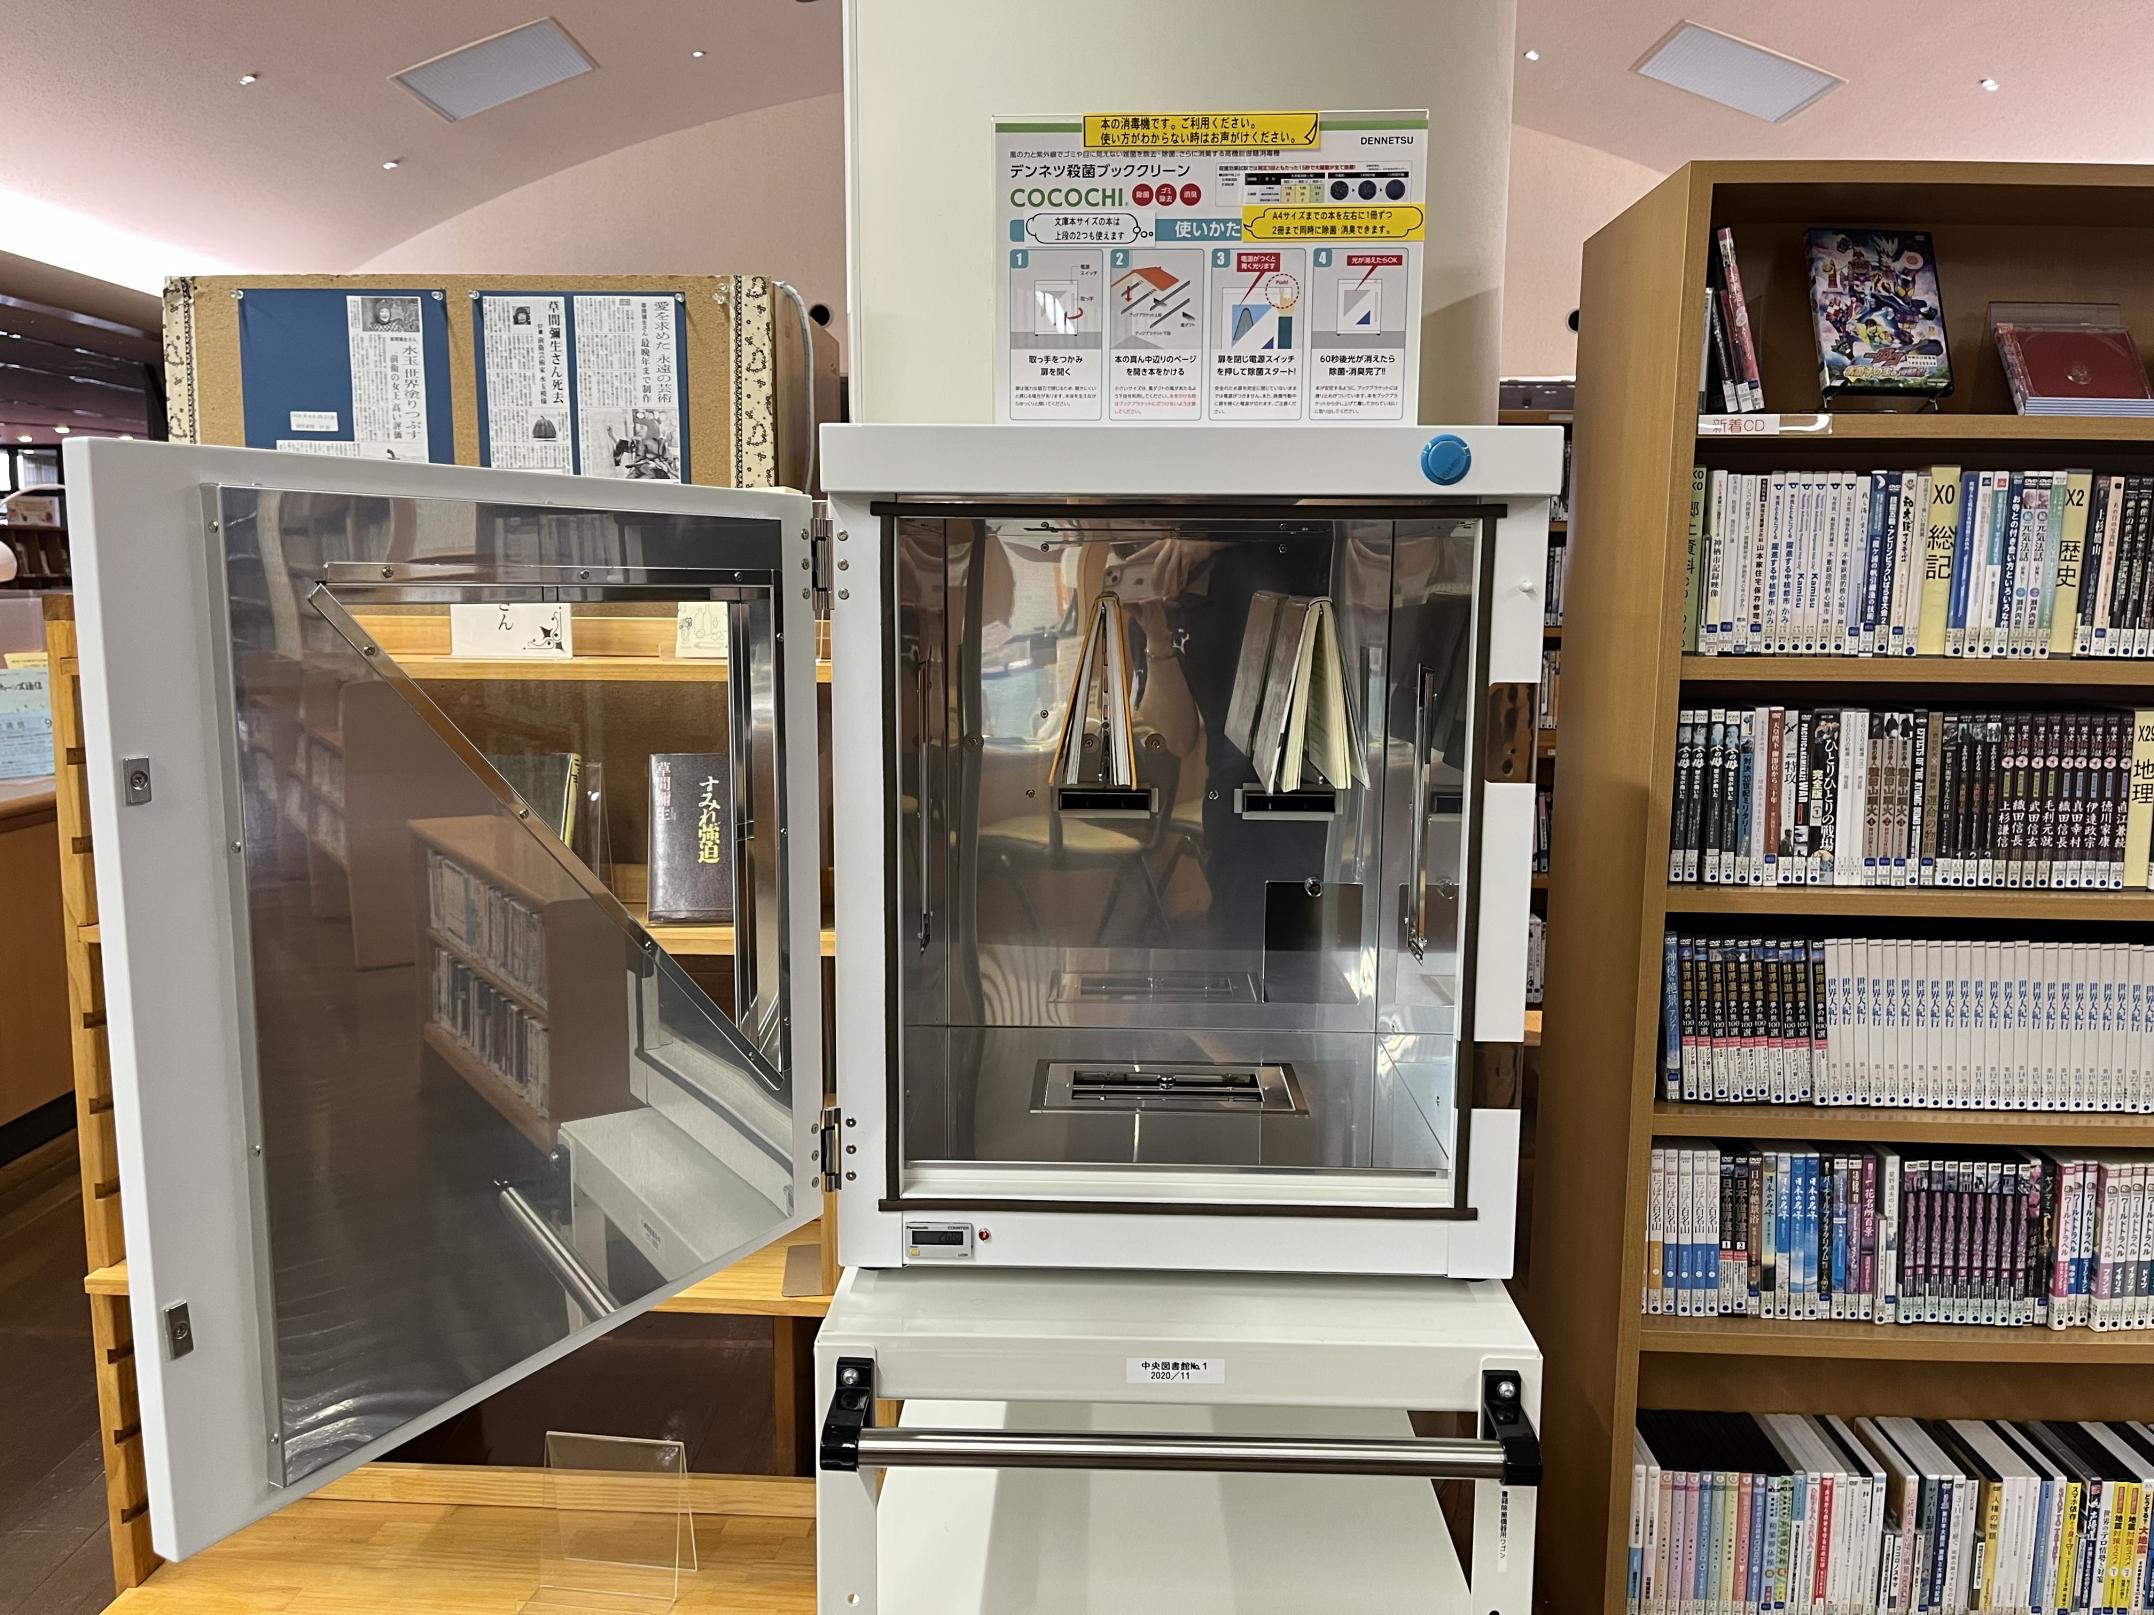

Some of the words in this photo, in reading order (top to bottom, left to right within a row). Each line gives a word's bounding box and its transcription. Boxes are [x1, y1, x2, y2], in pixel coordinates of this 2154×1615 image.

[1100, 116, 1257, 130] 本の消毒機です。ご利用ください。
[1100, 131, 1296, 145] 使い方がわからない時はお声がけください。
[1360, 136, 1414, 145] DENNETSU
[1010, 164, 1190, 178] デンネツ殺菌ブッククリーン
[1010, 188, 1123, 208] COCOCHI
[1054, 216, 1120, 226] 文庫本サイズの本は
[1175, 220, 1241, 238] 使いかた
[1272, 211, 1392, 221] A4サイズまでの本を左右に1冊ずつ
[1272, 225, 1391, 236] 2冊まで同時に除菌・消臭できます。
[1054, 231, 1125, 241] 上段の2つも使えます
[1015, 252, 1023, 265] 1
[1116, 252, 1124, 265] 2
[1216, 251, 1225, 265] 3
[1318, 251, 1327, 265] 4
[654, 301, 671, 351] 愛を求めた
[402, 345, 419, 366] 水玉
[548, 300, 564, 404] 草間彌生さん死去
[1029, 355, 1083, 364] 取っ手をつかみ
[1114, 354, 1197, 364] 本の真ん中辺りのページ
[1217, 355, 1295, 364] 扉を閉じ電源スイッチ
[1319, 355, 1395, 363] 60秒後光が消えたら
[640, 338, 652, 404] 最晩年まで制作
[655, 353, 672, 404] 永遠の芸術
[1040, 368, 1071, 376] 扉を開く
[1126, 367, 1186, 376] を開き本をかける
[1216, 367, 1296, 376] を押して除菌スタート!
[404, 368, 422, 440] 世界塗りつぶす
[1712, 418, 1765, 433] 新着CD
[1933, 484, 1955, 505] X0
[2065, 489, 2085, 507] X2
[1926, 524, 1955, 580] 総記
[2056, 540, 2081, 587] 歴史
[1796, 573, 1804, 609] Kamisu
[1809, 573, 1819, 609] Kamisu
[2138, 725, 2154, 742] X29
[1784, 760, 1796, 785] 特攻
[1812, 769, 1823, 800] 完全版
[2132, 759, 2154, 804] 地理
[655, 762, 672, 822] 草間彌生
[1798, 781, 1809, 803] WAR
[1820, 739, 1839, 852] ひとりひとりの戦場
[698, 776, 721, 864] すみれ強迫
[1998, 801, 2011, 848] 上杉謙信
[2011, 800, 2025, 847] 織田信長
[2026, 801, 2040, 848] 武田信玄
[2040, 800, 2055, 848] 毛利元就
[2056, 801, 2070, 848] 織田信長
[2070, 800, 2084, 848] 真田幸村
[2084, 802, 2098, 848] 伊達政宗
[2098, 800, 2113, 848] 徳川家康
[2114, 801, 2128, 848] 直江兼続
[1683, 1000, 1694, 1035] 夢の旅100選
[1698, 1000, 1709, 1035] 夢の旅100選
[1713, 1001, 1725, 1036] 夢の旅100選
[1728, 1000, 1739, 1035] 夢の旅100選
[1741, 1001, 1753, 1035] 夢の旅100選
[1755, 1000, 1766, 1035] 夢の旅100選
[1768, 1001, 1780, 1036] 夢の旅100選
[1784, 1002, 1795, 1037] 夢の旅100選
[1797, 1001, 1808, 1035] 夢の旅100選
[1815, 1003, 1827, 1038] 夢の旅100選
[1652, 1175, 1662, 1232] にっぽん百名山
[1666, 1176, 1676, 1233] にっぽん百名山
[1681, 1177, 1690, 1234] にっぽん百名山
[1695, 1176, 1705, 1233] にっぽん百名山
[1708, 1176, 1718, 1233] にっぽん百名山
[1764, 1176, 1775, 1219] 日本の名峰
[1778, 1178, 1789, 1221] 日本の名峰
[1792, 1177, 1803, 1220] 日本の名峰
[1806, 1177, 1818, 1220] 日本の名峰
[2061, 1197, 2072, 1256] ワールドトラベル
[2070, 1194, 2080, 1253] ワールドトラベル
[2083, 1194, 2095, 1253] ワールドトラベル
[2104, 1199, 2115, 1258] ワールドトラベル
[2116, 1198, 2128, 1257] ワールドトラベル
[2129, 1197, 2141, 1255] ワールドトラベル
[2142, 1197, 2154, 1255] ワールドトラベル
[2102, 1269, 2111, 1295] フランス
[2114, 1268, 2122, 1294] イギリス
[2127, 1266, 2135, 1292] イタリア
